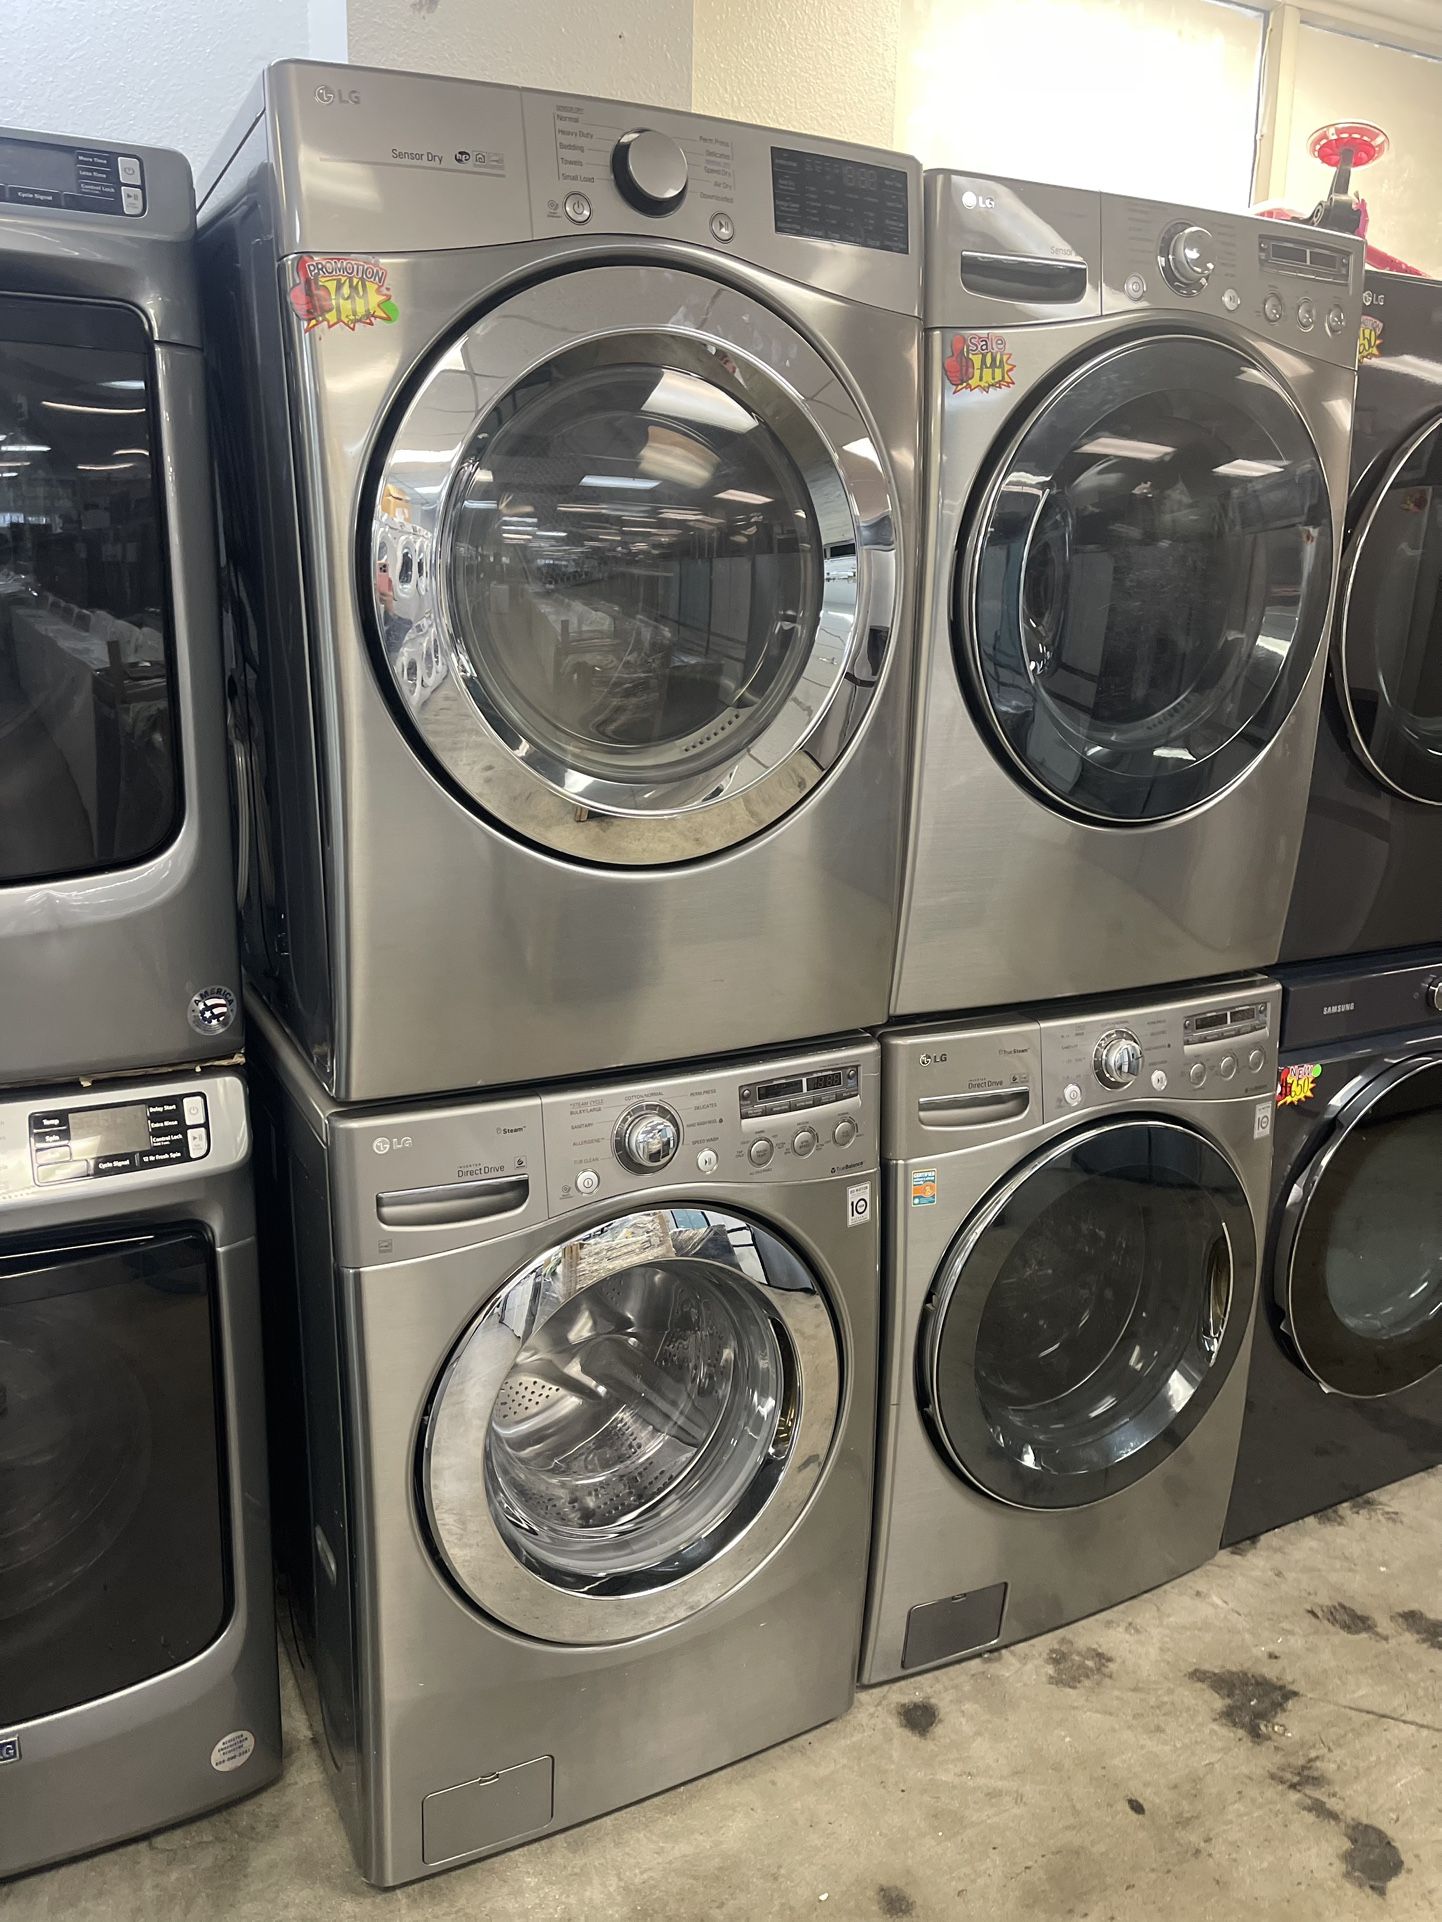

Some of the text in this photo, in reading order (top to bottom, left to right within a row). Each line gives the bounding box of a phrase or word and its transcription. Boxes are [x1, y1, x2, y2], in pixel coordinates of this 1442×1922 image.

[339, 88, 361, 104] LG
[557, 113, 580, 123] Normal
[558, 128, 594, 140] Heavy Duty
[559, 142, 585, 153] Bedding
[391, 148, 444, 165] Sensor Dry
[560, 157, 583, 167] Towels
[562, 173, 595, 183] Small Load
[17, 191, 34, 199] Cycle
[979, 196, 996, 208] LG
[1050, 246, 1074, 257] Sensor
[307, 261, 385, 285] PROMOTION
[1373, 293, 1385, 306] LG
[968, 332, 1005, 353] Sale
[194, 987, 234, 1006] AMERICA
[1323, 1002, 1355, 1015] SAMSUNG
[933, 1053, 948, 1063] LG
[968, 1079, 1003, 1090] Direct Drive
[571, 1122, 594, 1130] SANITARY
[1258, 1115, 1269, 1131] 10
[172, 1133, 183, 1141] Lock
[392, 1136, 413, 1150] LG
[170, 1151, 181, 1159] Spin
[113, 1159, 130, 1167] Signal
[457, 1165, 505, 1178] Direct Drive
[851, 1198, 868, 1218] 10
